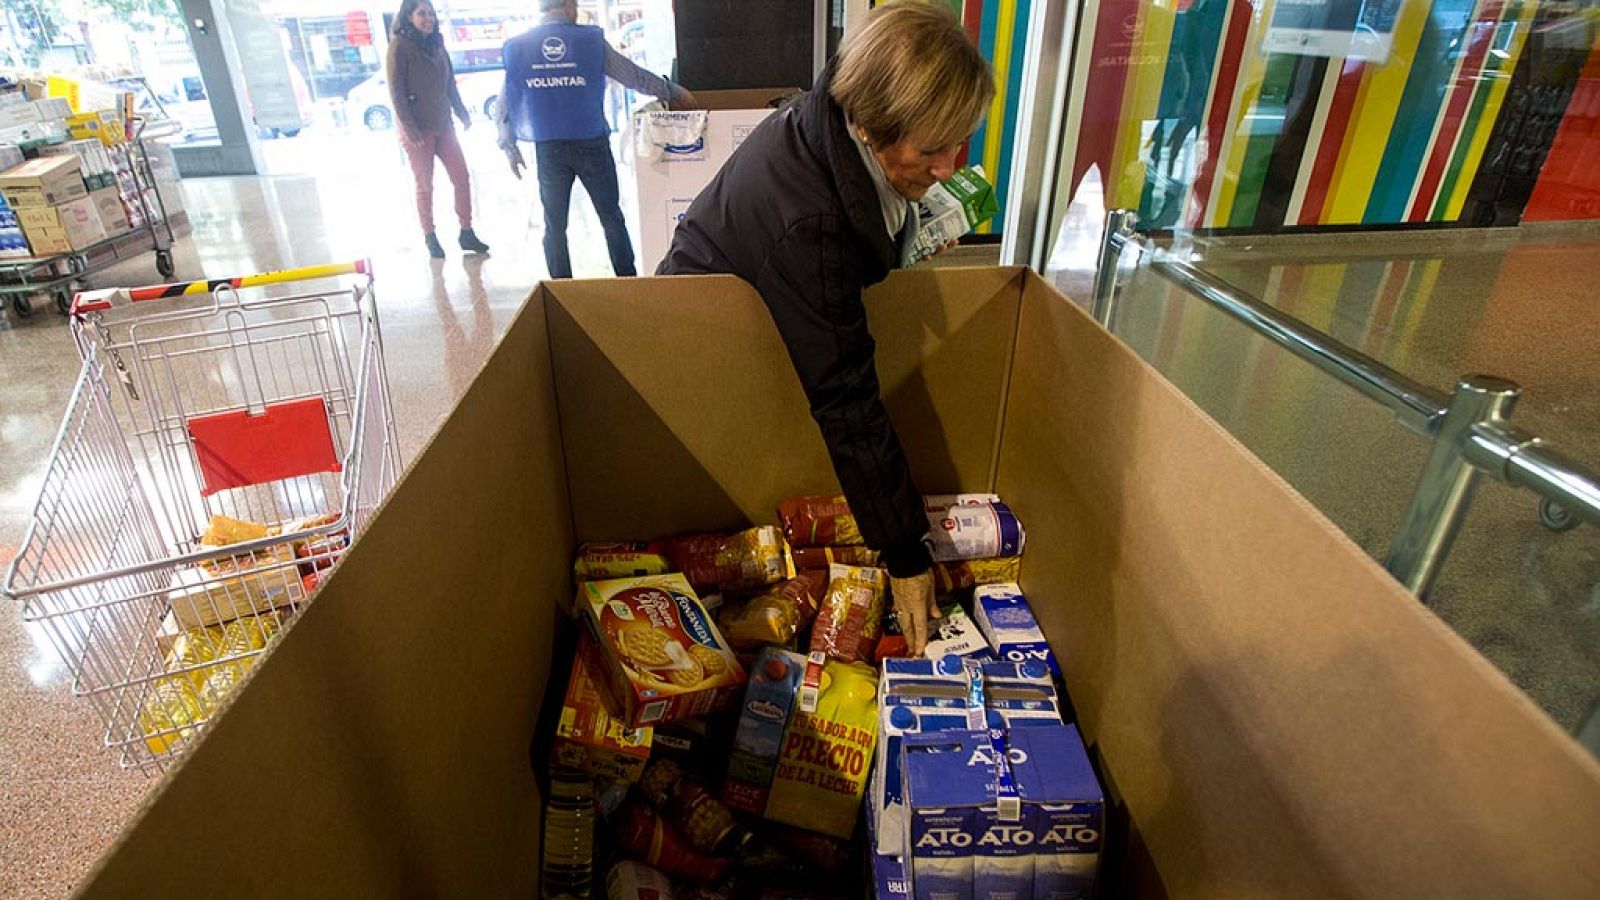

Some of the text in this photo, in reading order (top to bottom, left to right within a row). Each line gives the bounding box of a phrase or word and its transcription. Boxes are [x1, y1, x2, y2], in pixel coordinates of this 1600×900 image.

[676, 596, 711, 644] FONTANEDA
[809, 716, 847, 738] SABOR
[848, 727, 857, 743] A
[782, 732, 864, 776] PRECIO
[776, 763, 859, 797] DE LA LECHE
[916, 827, 973, 848] ATO
[976, 825, 1035, 846] ATO
[1038, 824, 1098, 845] ATO
